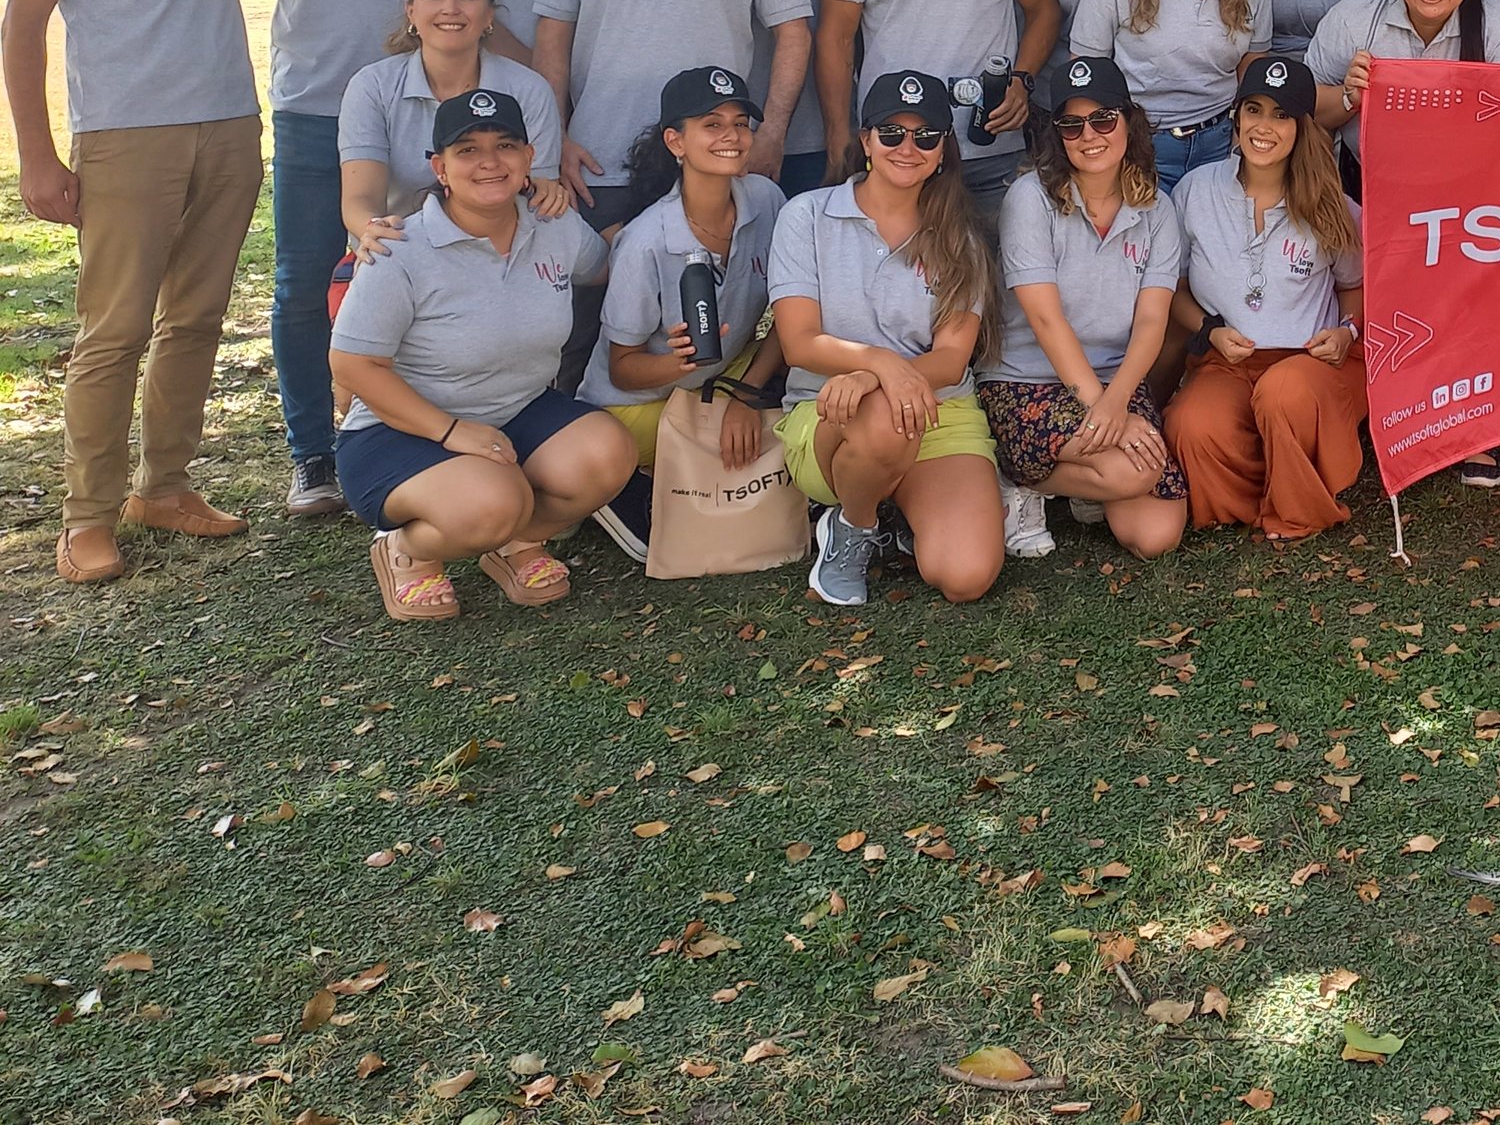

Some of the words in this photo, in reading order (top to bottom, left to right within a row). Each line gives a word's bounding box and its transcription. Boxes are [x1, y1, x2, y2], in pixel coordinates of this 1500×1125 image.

[1282, 238, 1310, 264] We
[698, 306, 709, 335] TSOFT
[1382, 406, 1413, 430] Follow
[1414, 401, 1426, 414] us
[722, 470, 784, 502] TSOFT
